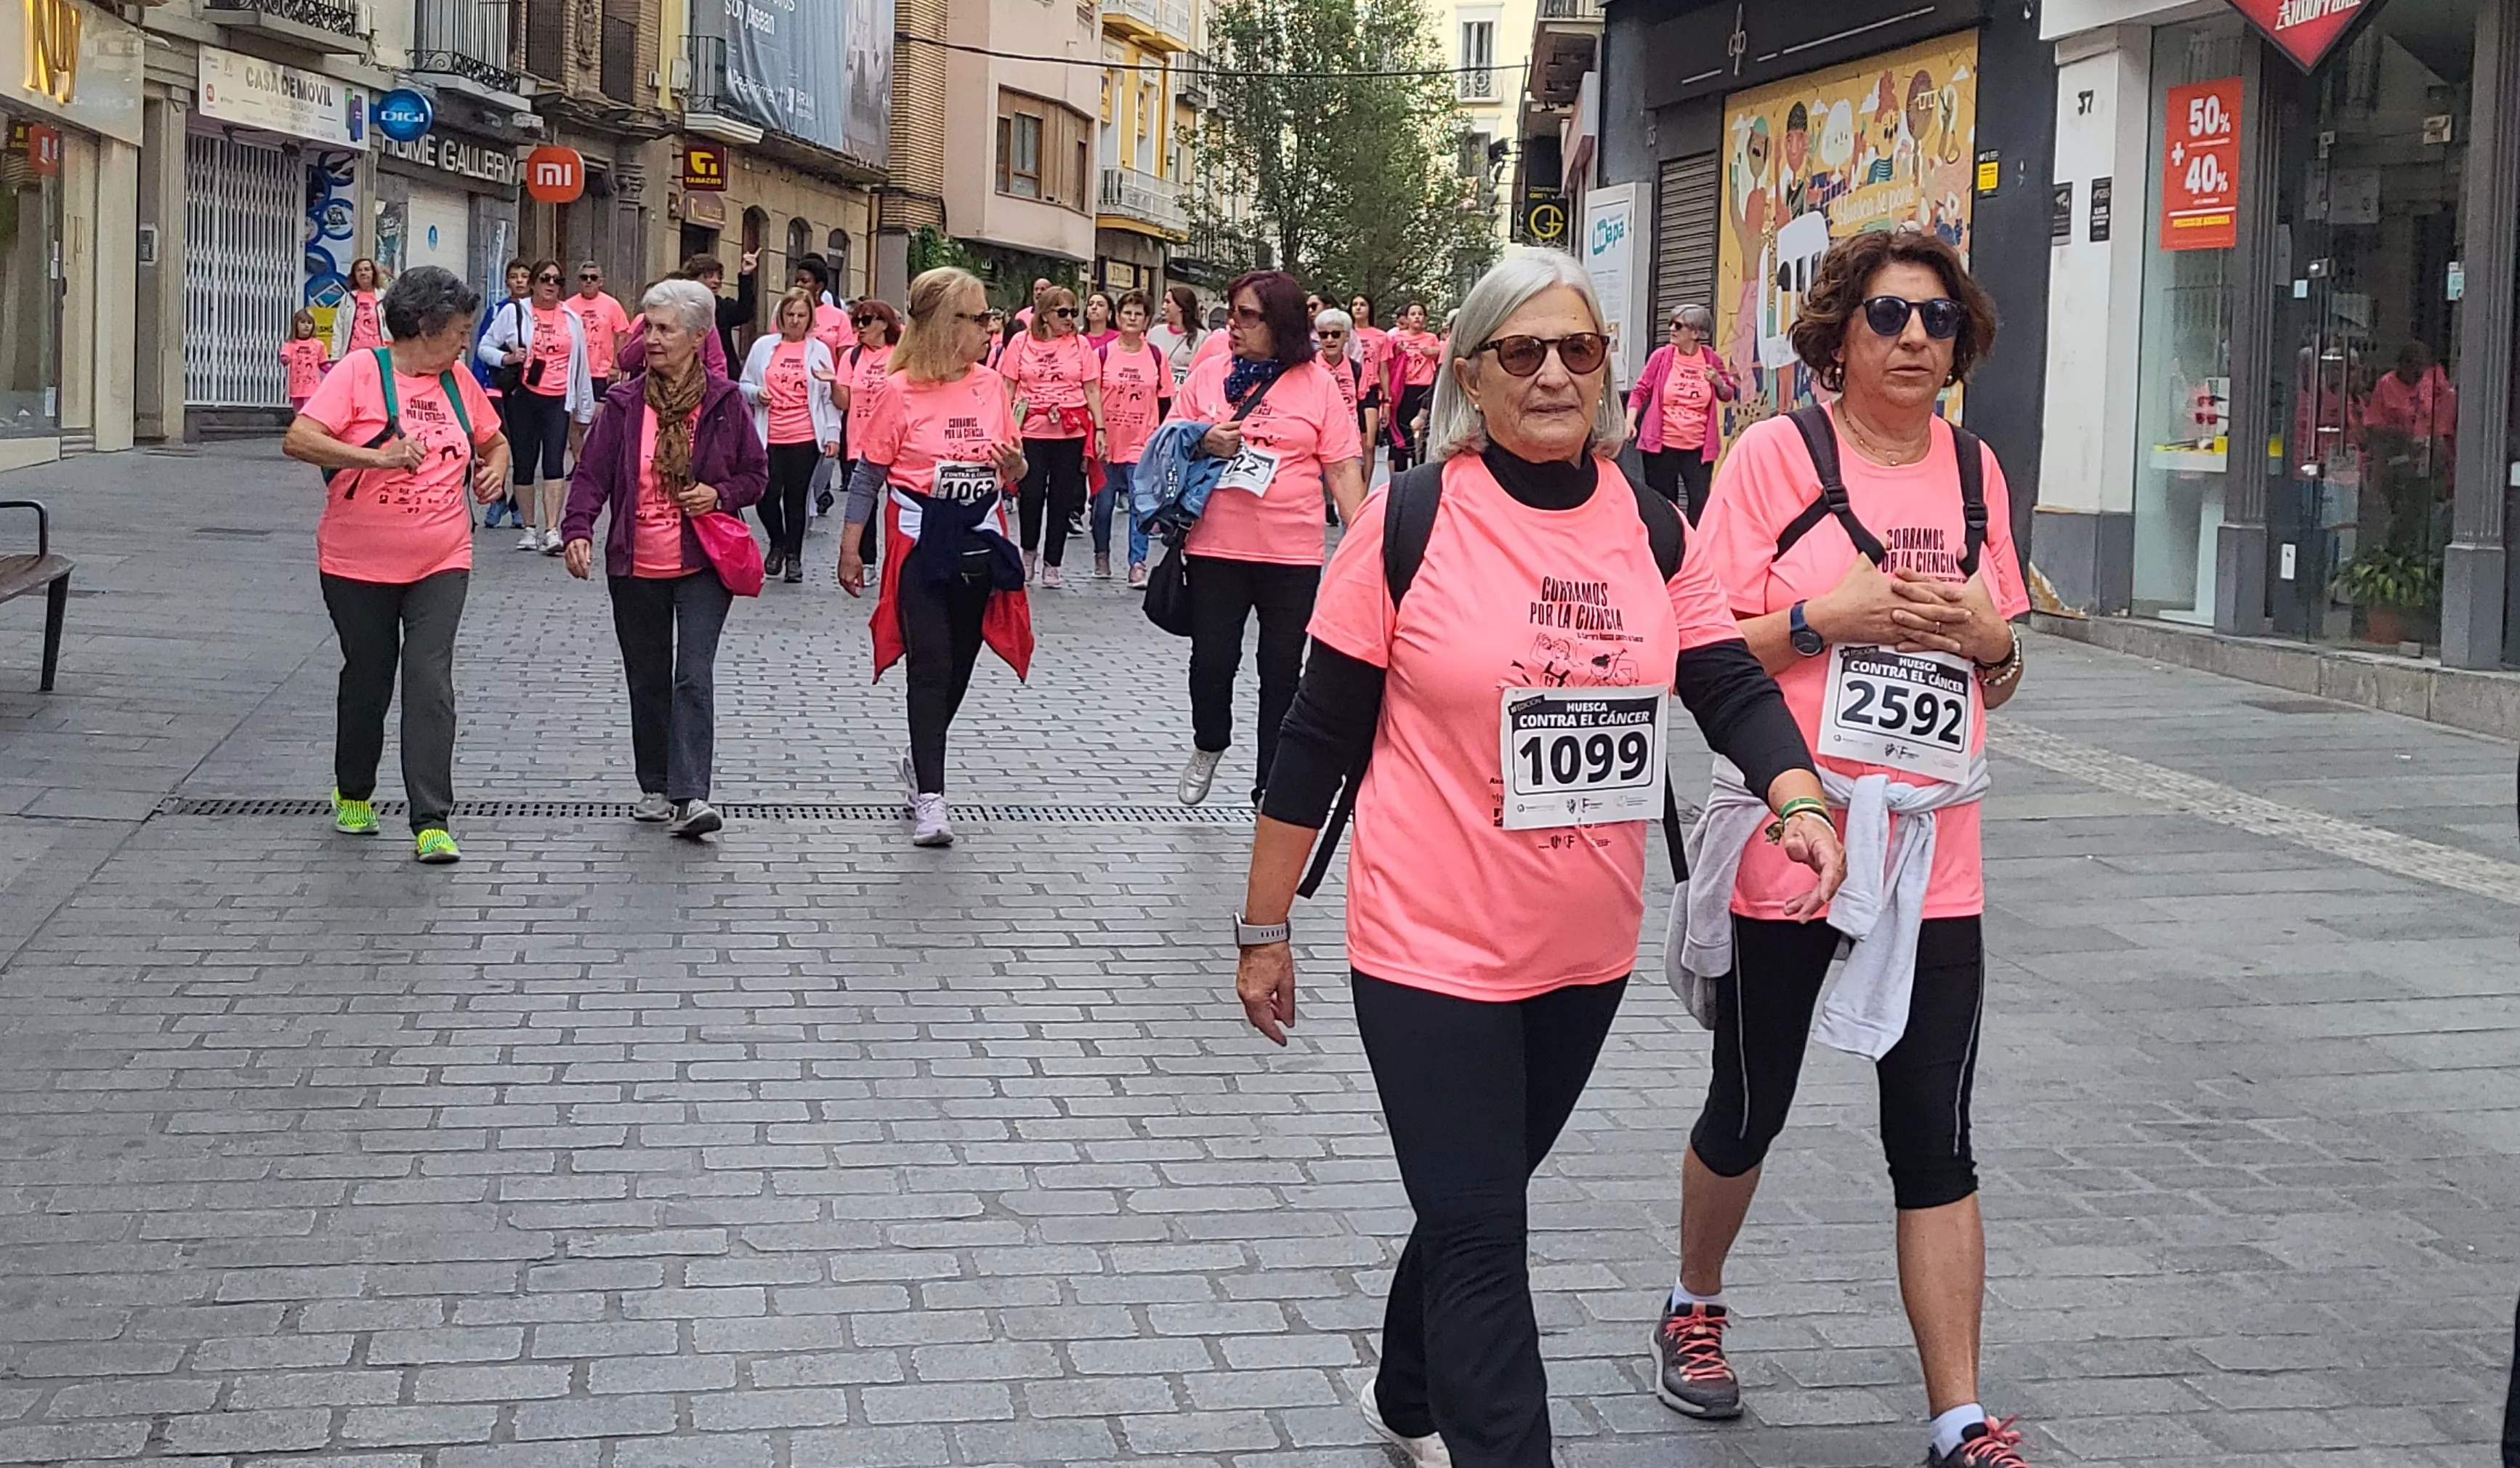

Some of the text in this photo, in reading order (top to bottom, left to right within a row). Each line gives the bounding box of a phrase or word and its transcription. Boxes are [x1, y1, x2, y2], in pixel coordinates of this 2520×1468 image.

[245, 66, 279, 95] CASA
[280, 74, 296, 97] DE
[297, 78, 333, 108] MÓVIL
[380, 110, 424, 123] DIGI
[2077, 89, 2094, 116] 37
[2189, 94, 2231, 137] 50%
[440, 138, 517, 186] GALLERY
[2184, 153, 2228, 195] 40%
[1886, 527, 1944, 551] CORRAMOS
[1881, 552, 1897, 573] OR
[1915, 552, 1956, 574] CIENCIA
[1541, 576, 1608, 607] CORRAMOS
[1530, 602, 1623, 632] POR LA CIENCIA
[1850, 660, 1964, 694] CONTRA EL CÁNCER
[1899, 657, 1937, 672] HUESCA
[1519, 710, 1650, 727] CONTRA EL CÁNCER
[1567, 702, 1608, 713] HUESCA
[1841, 679, 1963, 745] 2592
[1519, 731, 1648, 786] 1099
